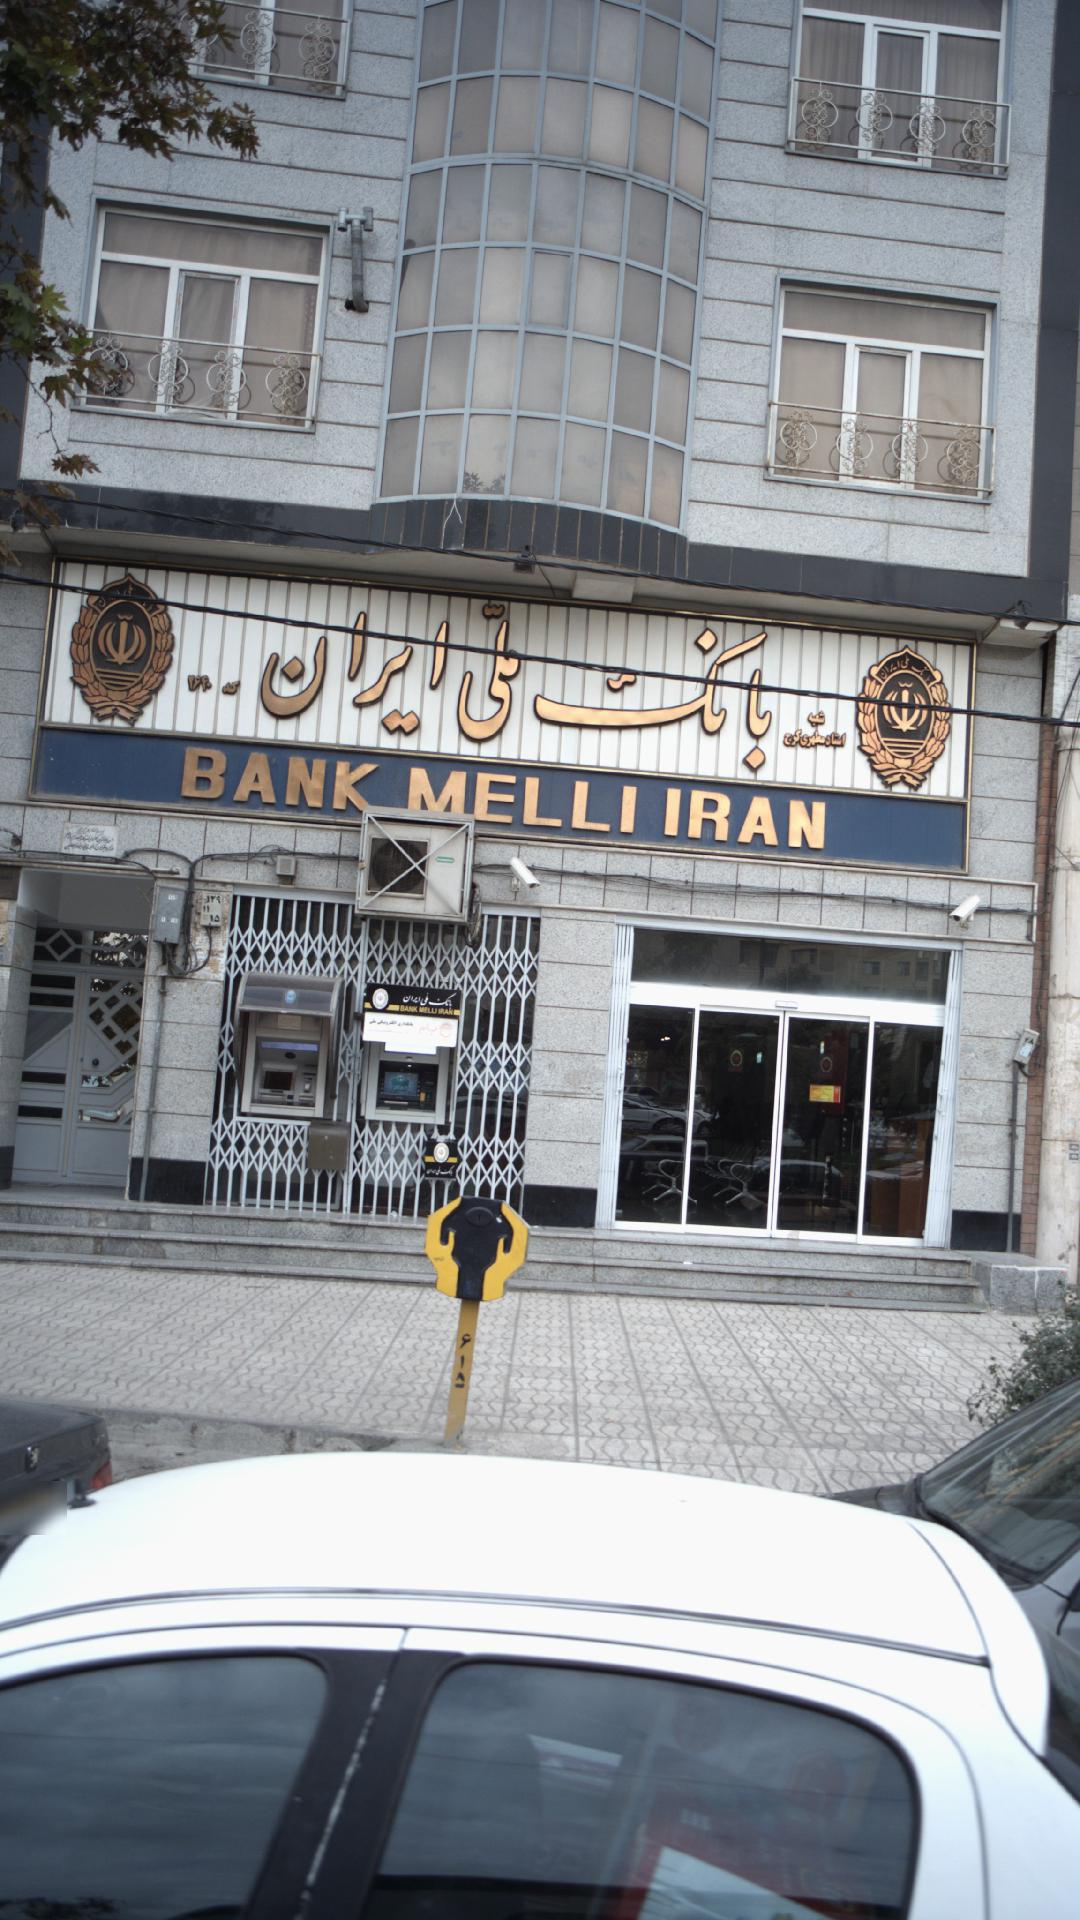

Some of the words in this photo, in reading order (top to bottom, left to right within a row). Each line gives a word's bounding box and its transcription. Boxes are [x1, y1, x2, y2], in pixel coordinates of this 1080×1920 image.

[261, 611, 450, 736] ایران
[533, 628, 773, 770] بانک
[180, 746, 379, 812] BANK
[407, 766, 638, 834] MELLI
[663, 787, 827, 850] IRAN
[400, 1005, 418, 1013] BANK
[438, 1009, 454, 1017] IRAN
[402, 995, 421, 1004] ایران
[428, 992, 457, 1011] بانک
